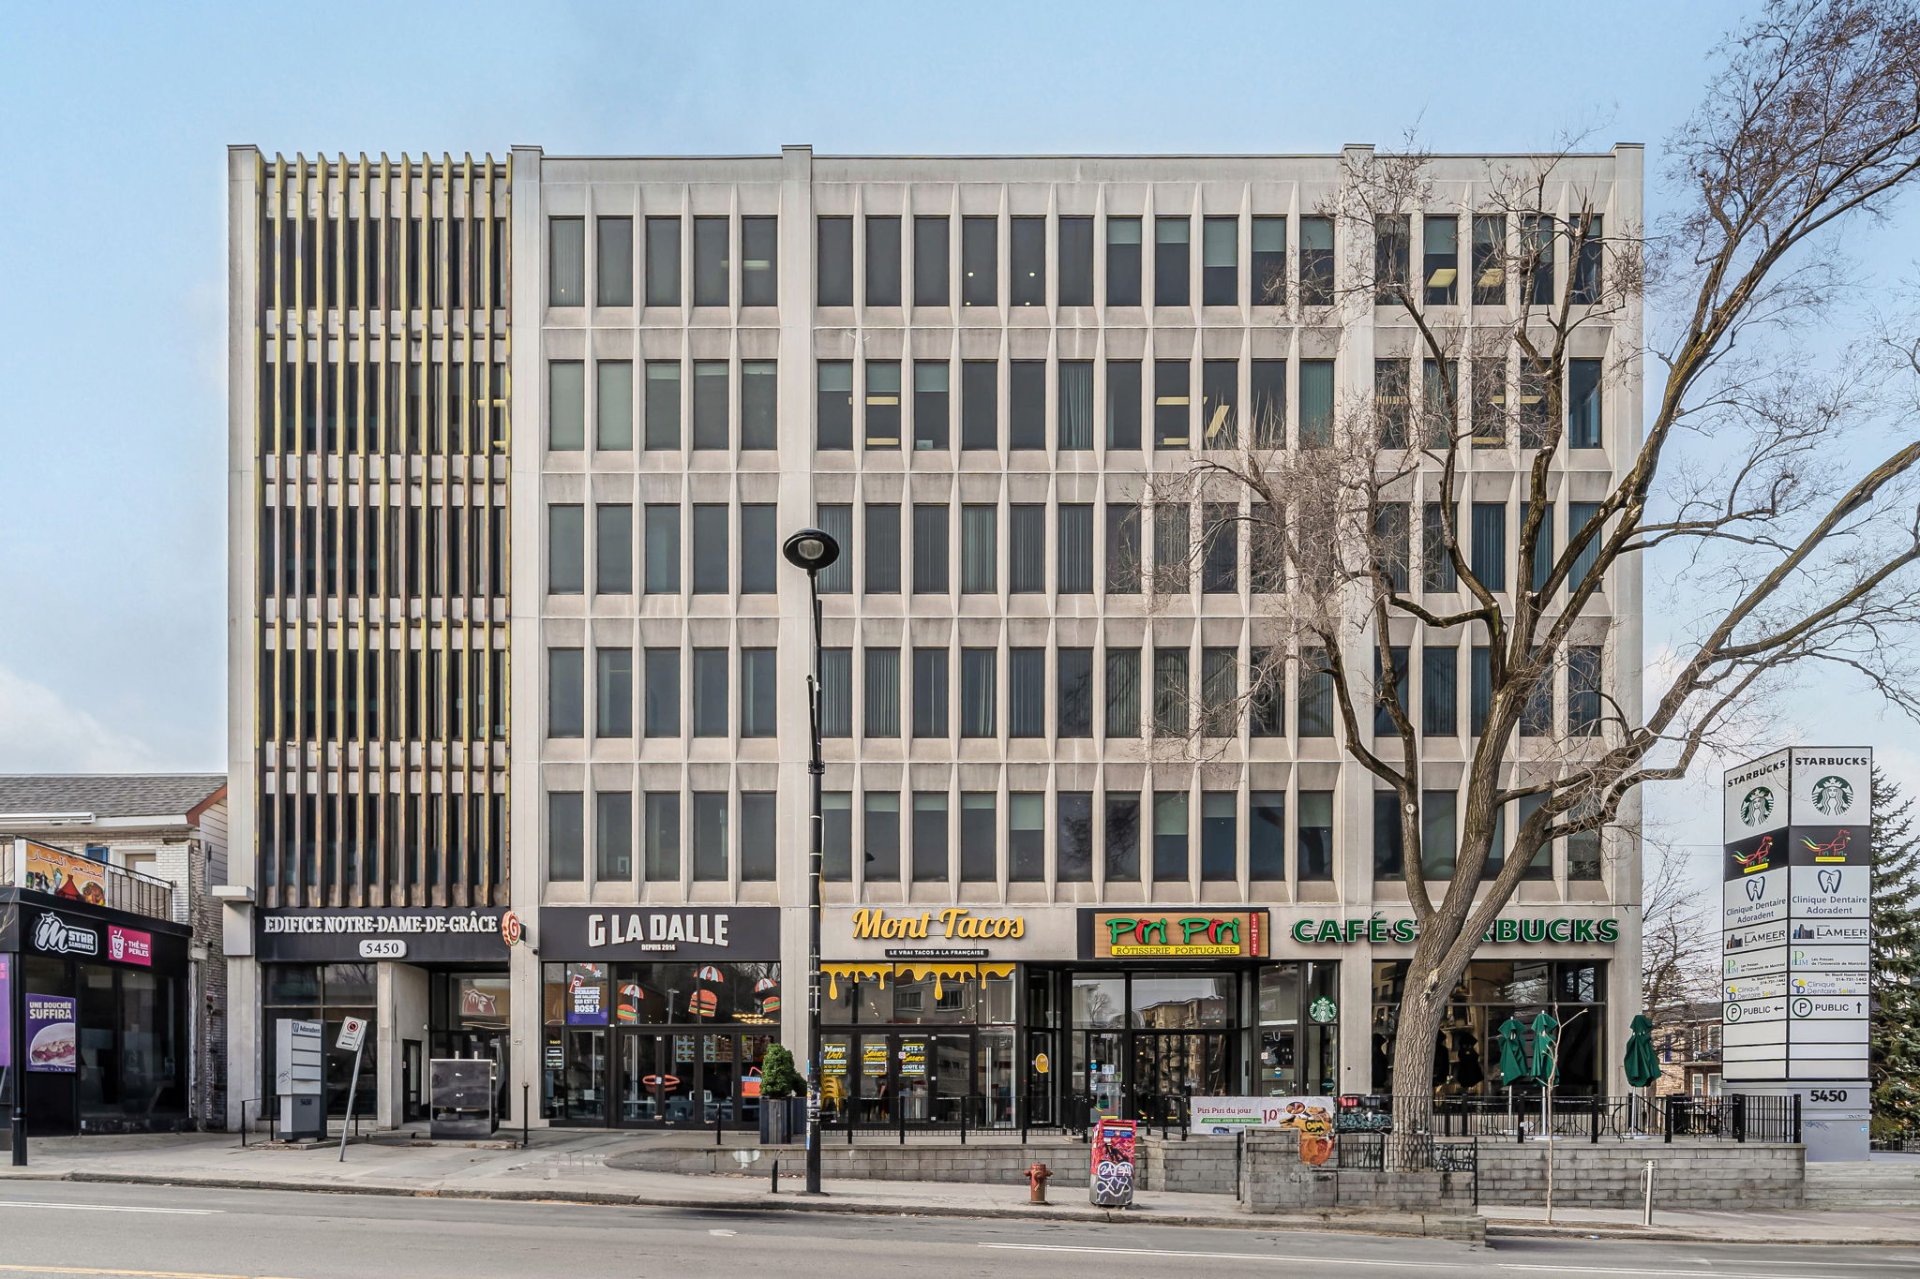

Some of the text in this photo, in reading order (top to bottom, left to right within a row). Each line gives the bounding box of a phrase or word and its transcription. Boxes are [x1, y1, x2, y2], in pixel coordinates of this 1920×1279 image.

[1795, 757, 1868, 766] STARBUCKS
[1728, 760, 1786, 788] STARBUCKS
[1726, 898, 1786, 916] Clinique Dentaire
[1792, 896, 1826, 906] Clinique
[1806, 906, 1852, 914] Adoradent
[264, 911, 498, 933] EDIFICE NOTRE-DAME-DE-GRÂCE
[852, 908, 1025, 938] Mont Tacos
[1737, 911, 1774, 924] Adoradent
[589, 914, 729, 947] G LA DALLE
[1106, 918, 1240, 944] Piri Piri
[1292, 910, 1620, 943] CAFÉ SBUCKS
[1817, 928, 1867, 936] LAMEER
[68, 930, 94, 944] STAR
[1745, 930, 1785, 944] LAMEER
[129, 948, 148, 957] PERLES
[365, 943, 400, 954] 5450
[1116, 945, 1236, 955] RÔTISSERIE PORTUGAISE
[29, 1009, 72, 1019] SUFFIRA
[1744, 1006, 1771, 1015] PUBLIC
[1810, 1090, 1847, 1102] 5450
